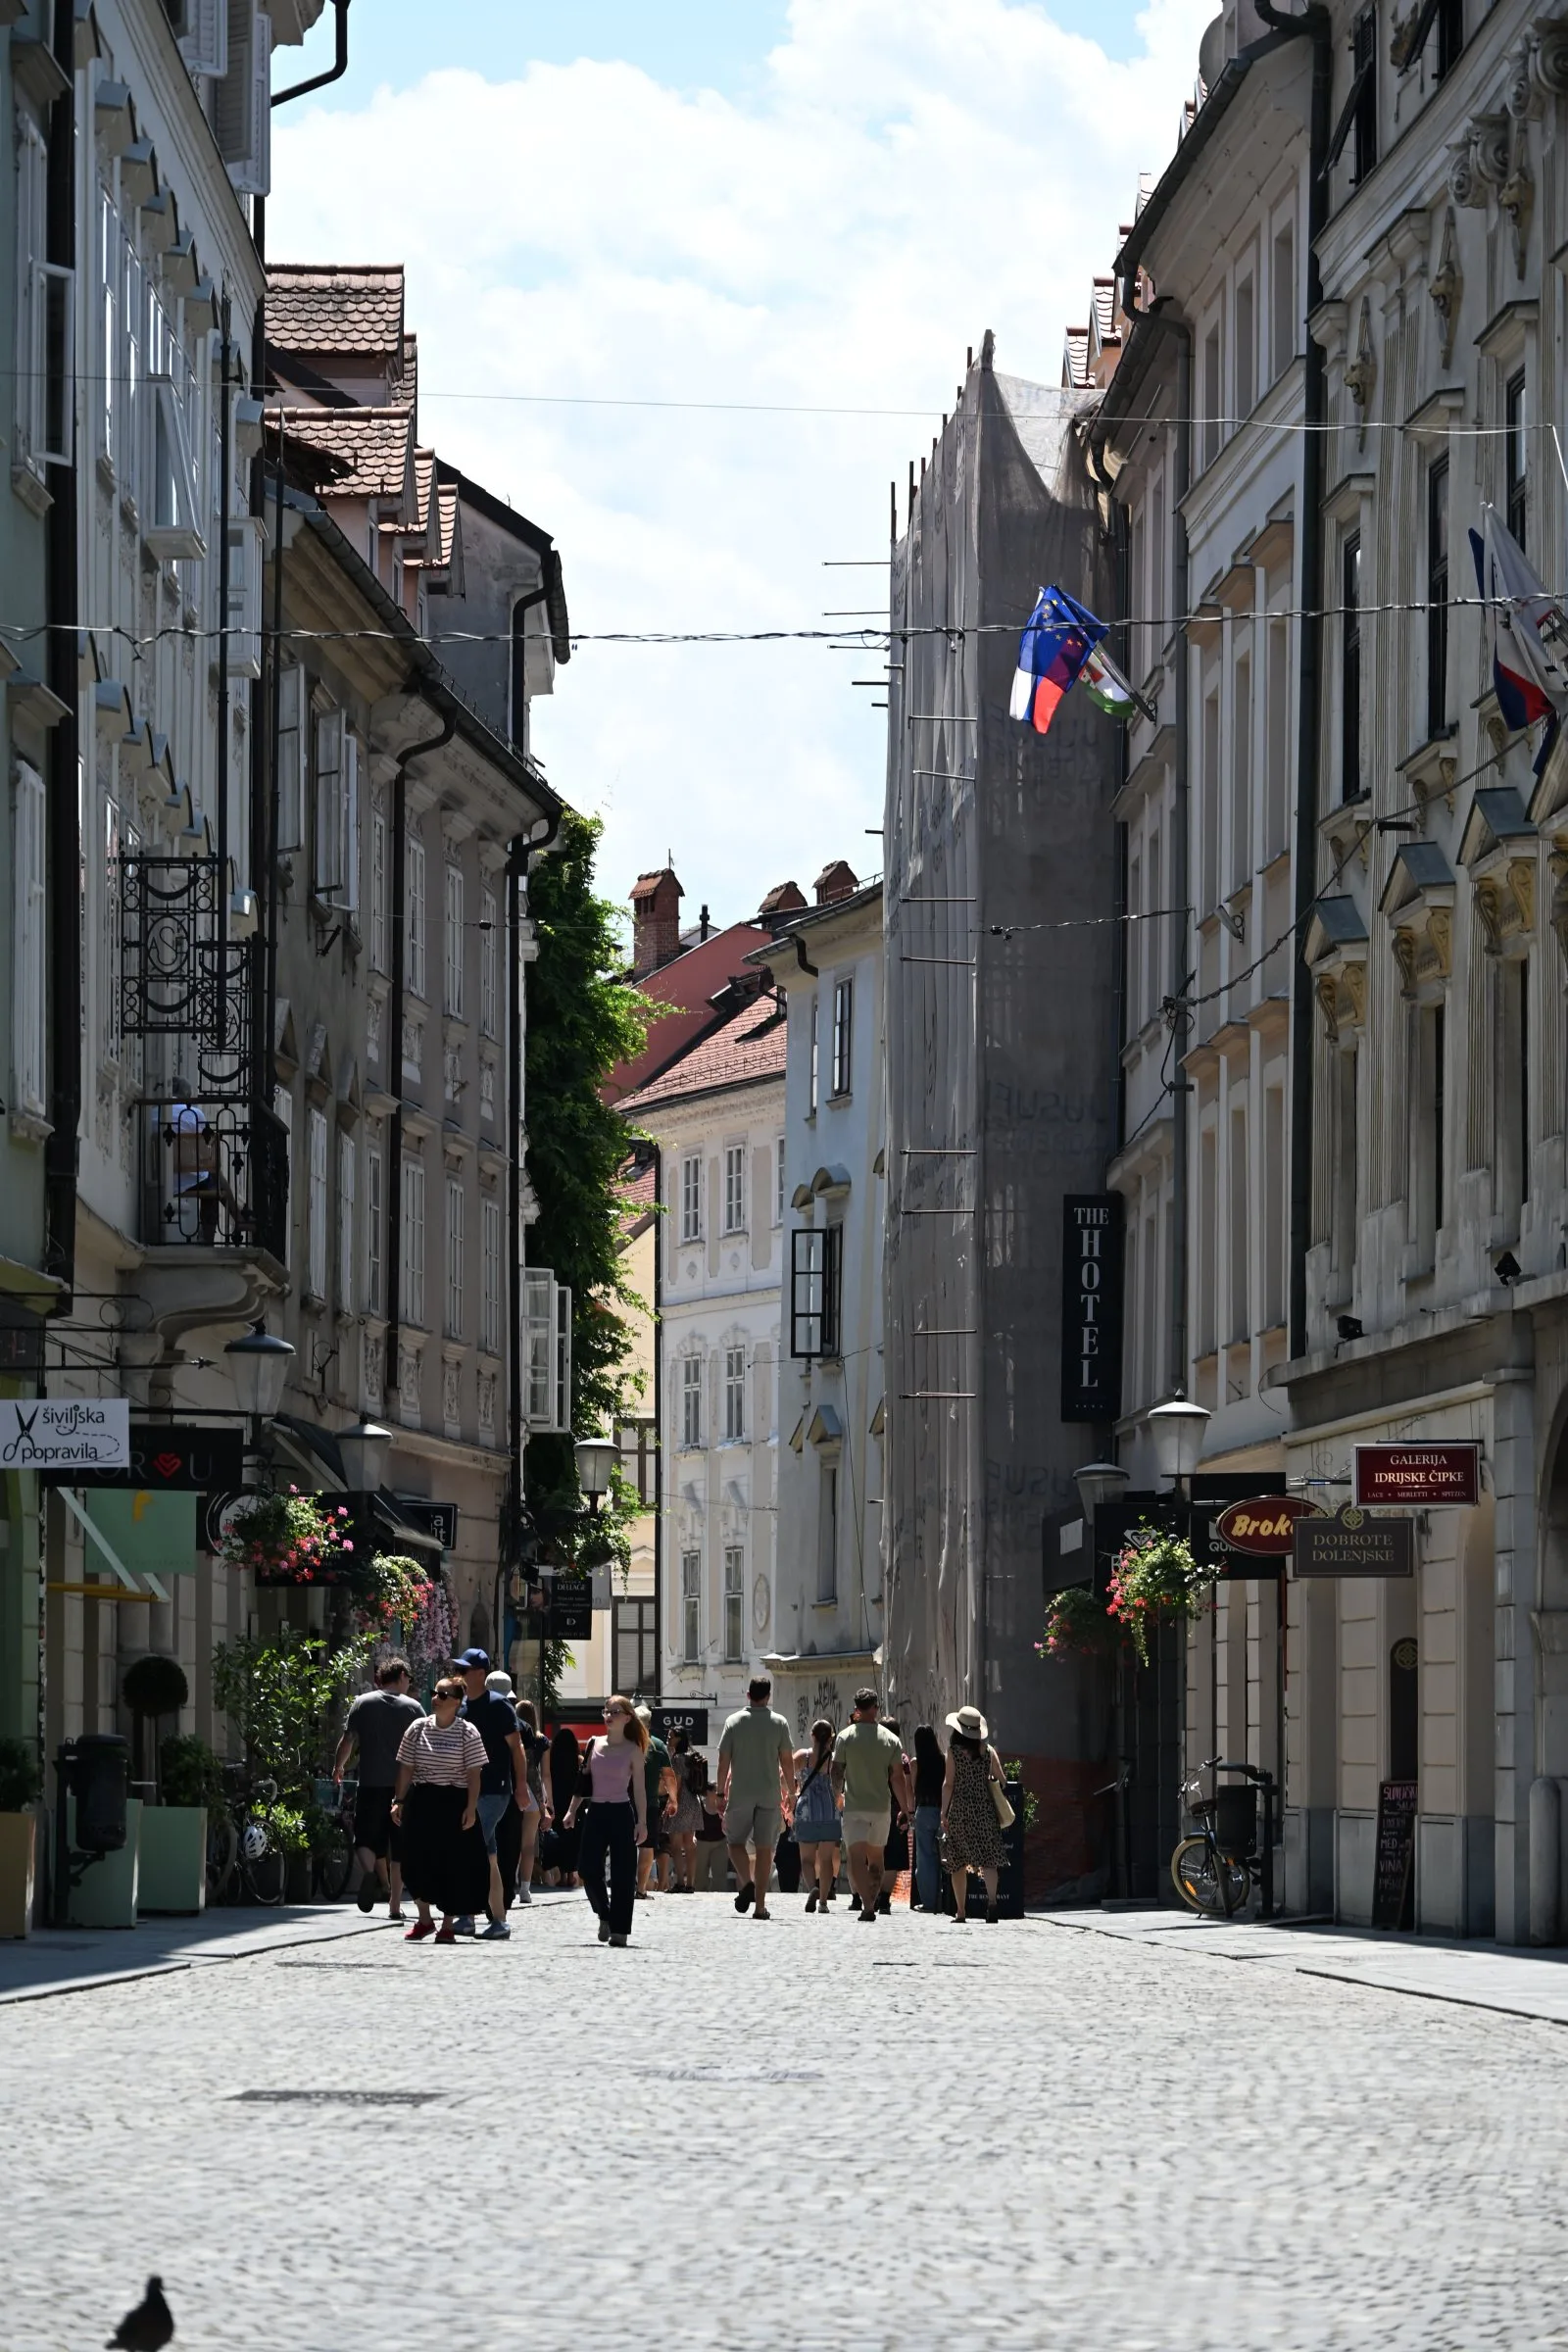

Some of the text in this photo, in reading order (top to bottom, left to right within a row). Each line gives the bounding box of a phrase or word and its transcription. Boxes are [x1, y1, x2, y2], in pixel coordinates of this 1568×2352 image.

[1073, 1207, 1109, 1225] THE
[1079, 1229, 1103, 1389] HOTEL
[42, 1404, 106, 1436] šiviljska
[22, 1443, 98, 1464] popravila
[1390, 1454, 1447, 1467] GALERIJA
[1374, 1469, 1464, 1485] IDRIJSKE ČIPKE
[1313, 1534, 1394, 1546] DOBROTE
[1312, 1549, 1395, 1564] DOLENJSKE
[662, 1716, 694, 1726] GUD
[1379, 1859, 1403, 1873] VINA
